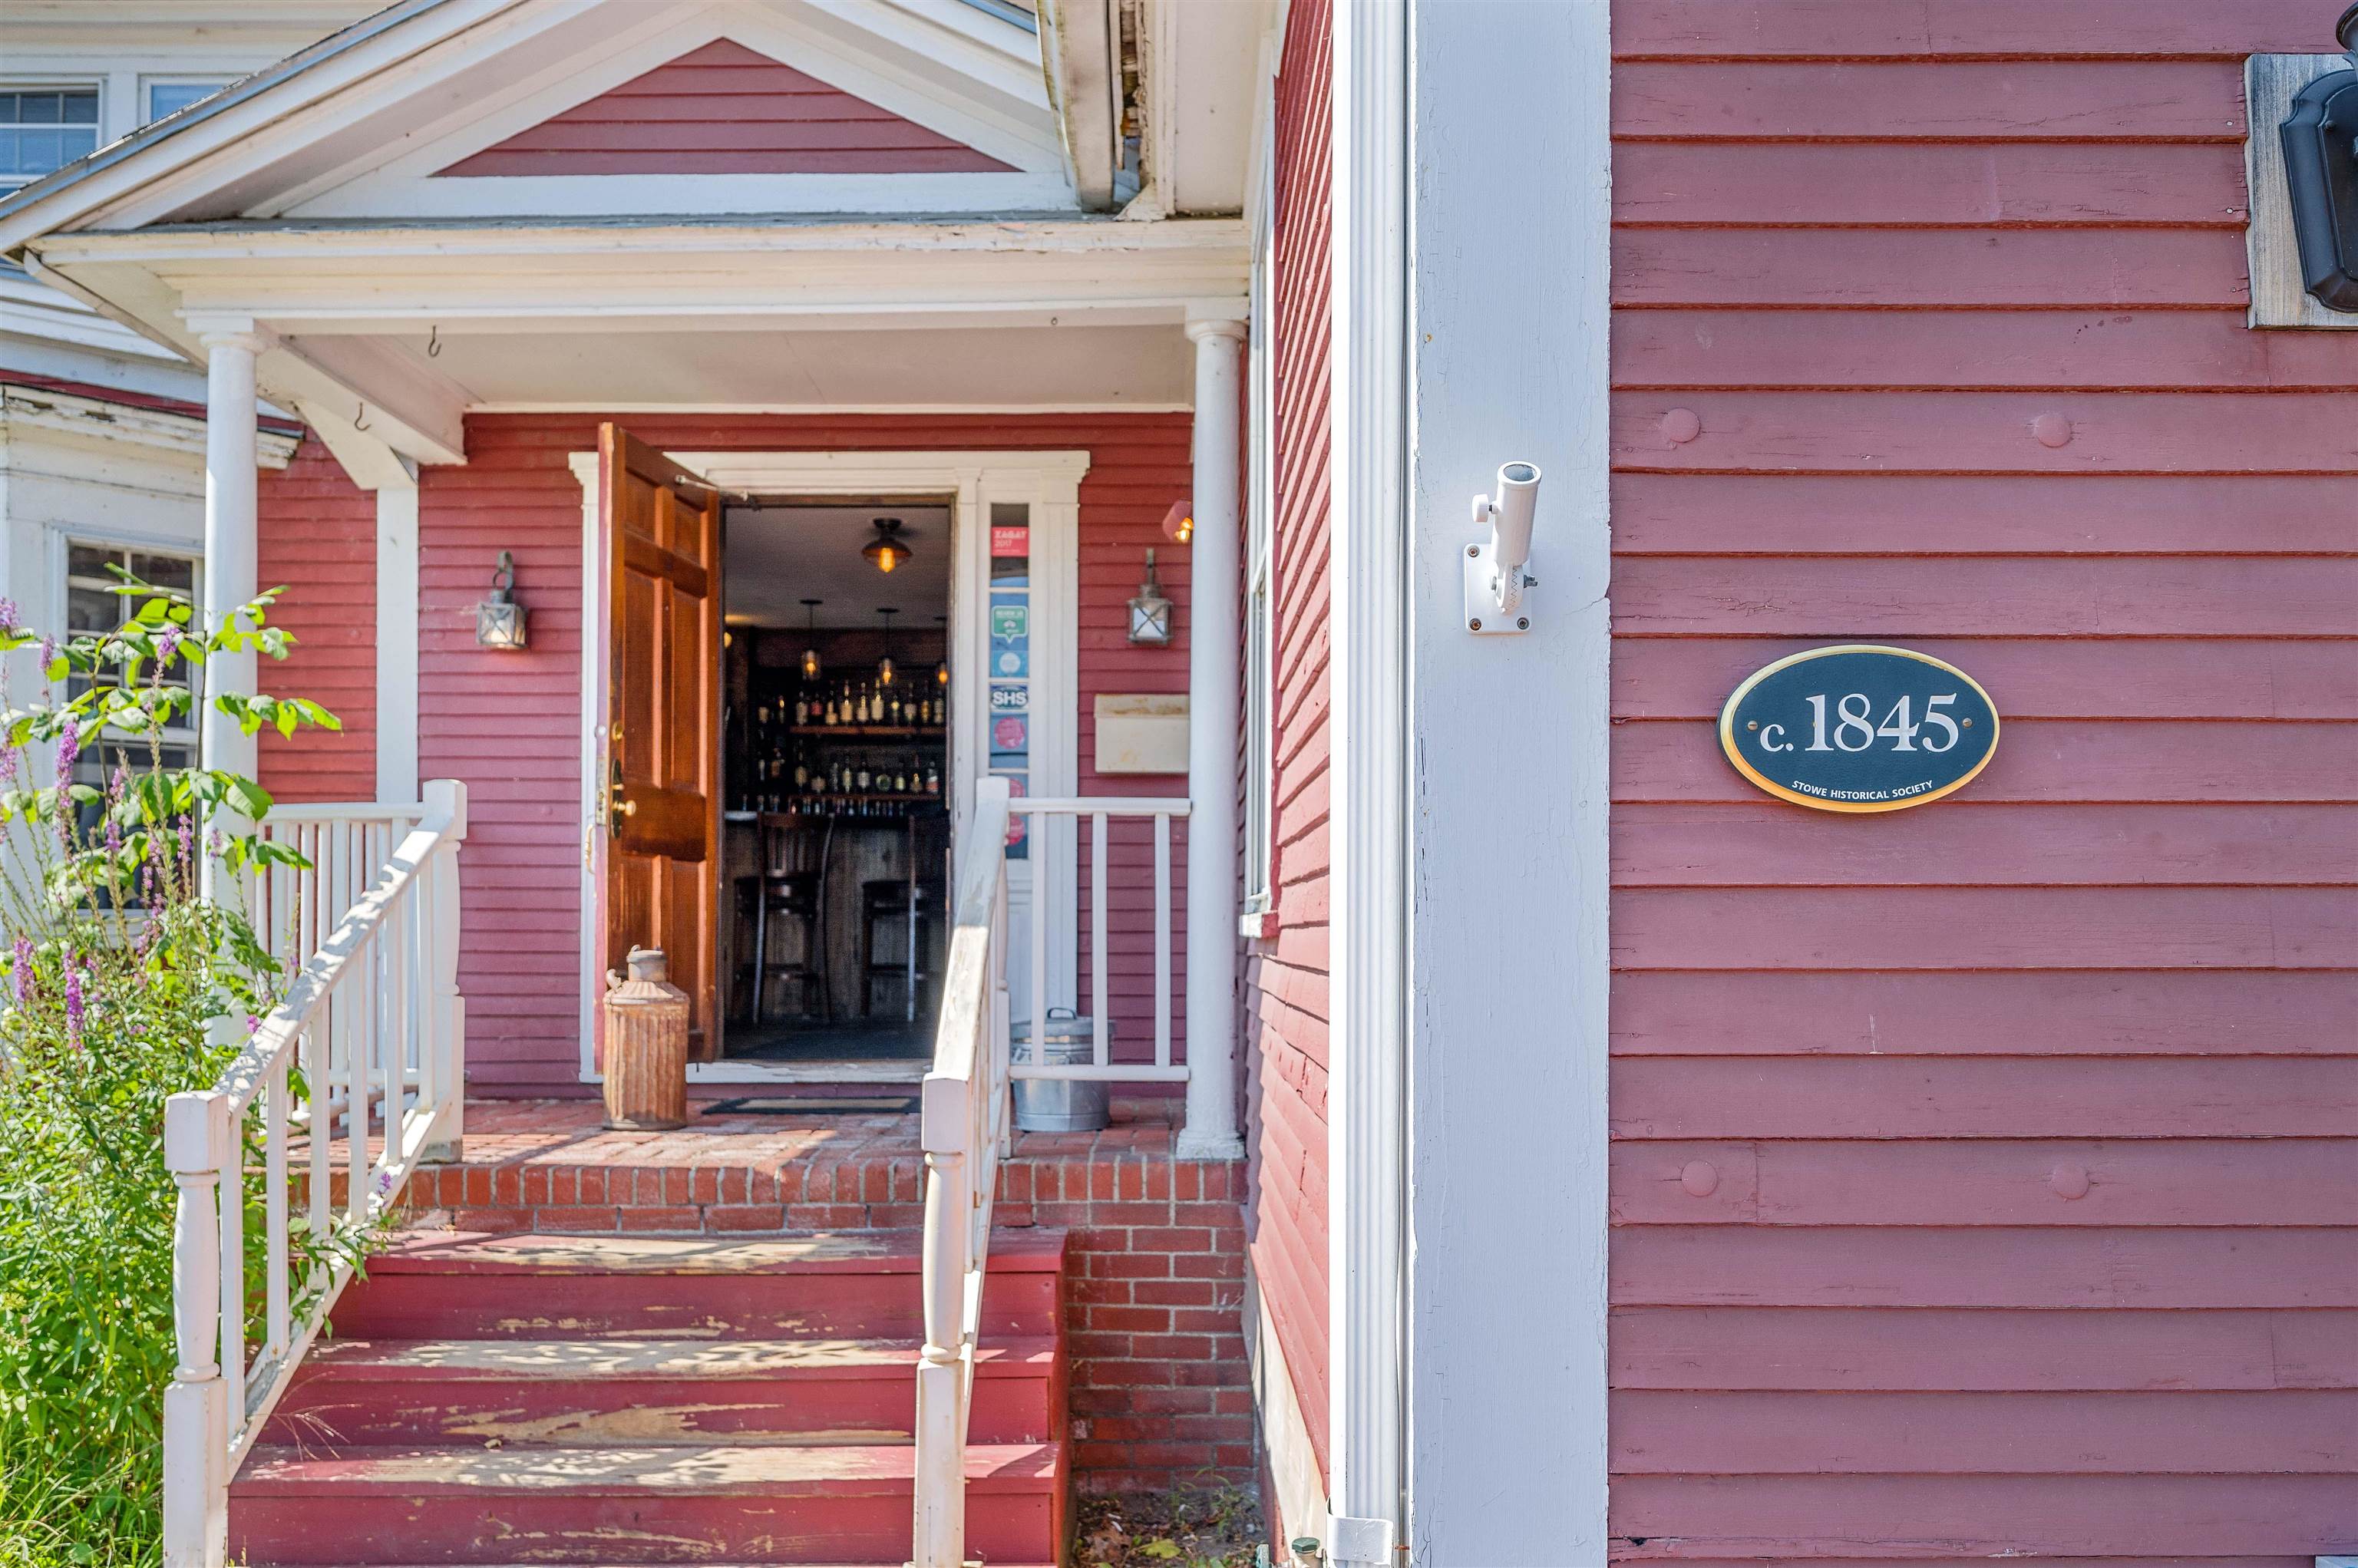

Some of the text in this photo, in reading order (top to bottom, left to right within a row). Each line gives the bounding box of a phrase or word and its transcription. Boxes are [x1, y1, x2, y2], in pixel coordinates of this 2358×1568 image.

[992, 691, 1027, 706] SHS
[1760, 693, 1959, 752] c. 1845
[1792, 780, 1934, 800] STOWE HISTORICAL SOCIETY
